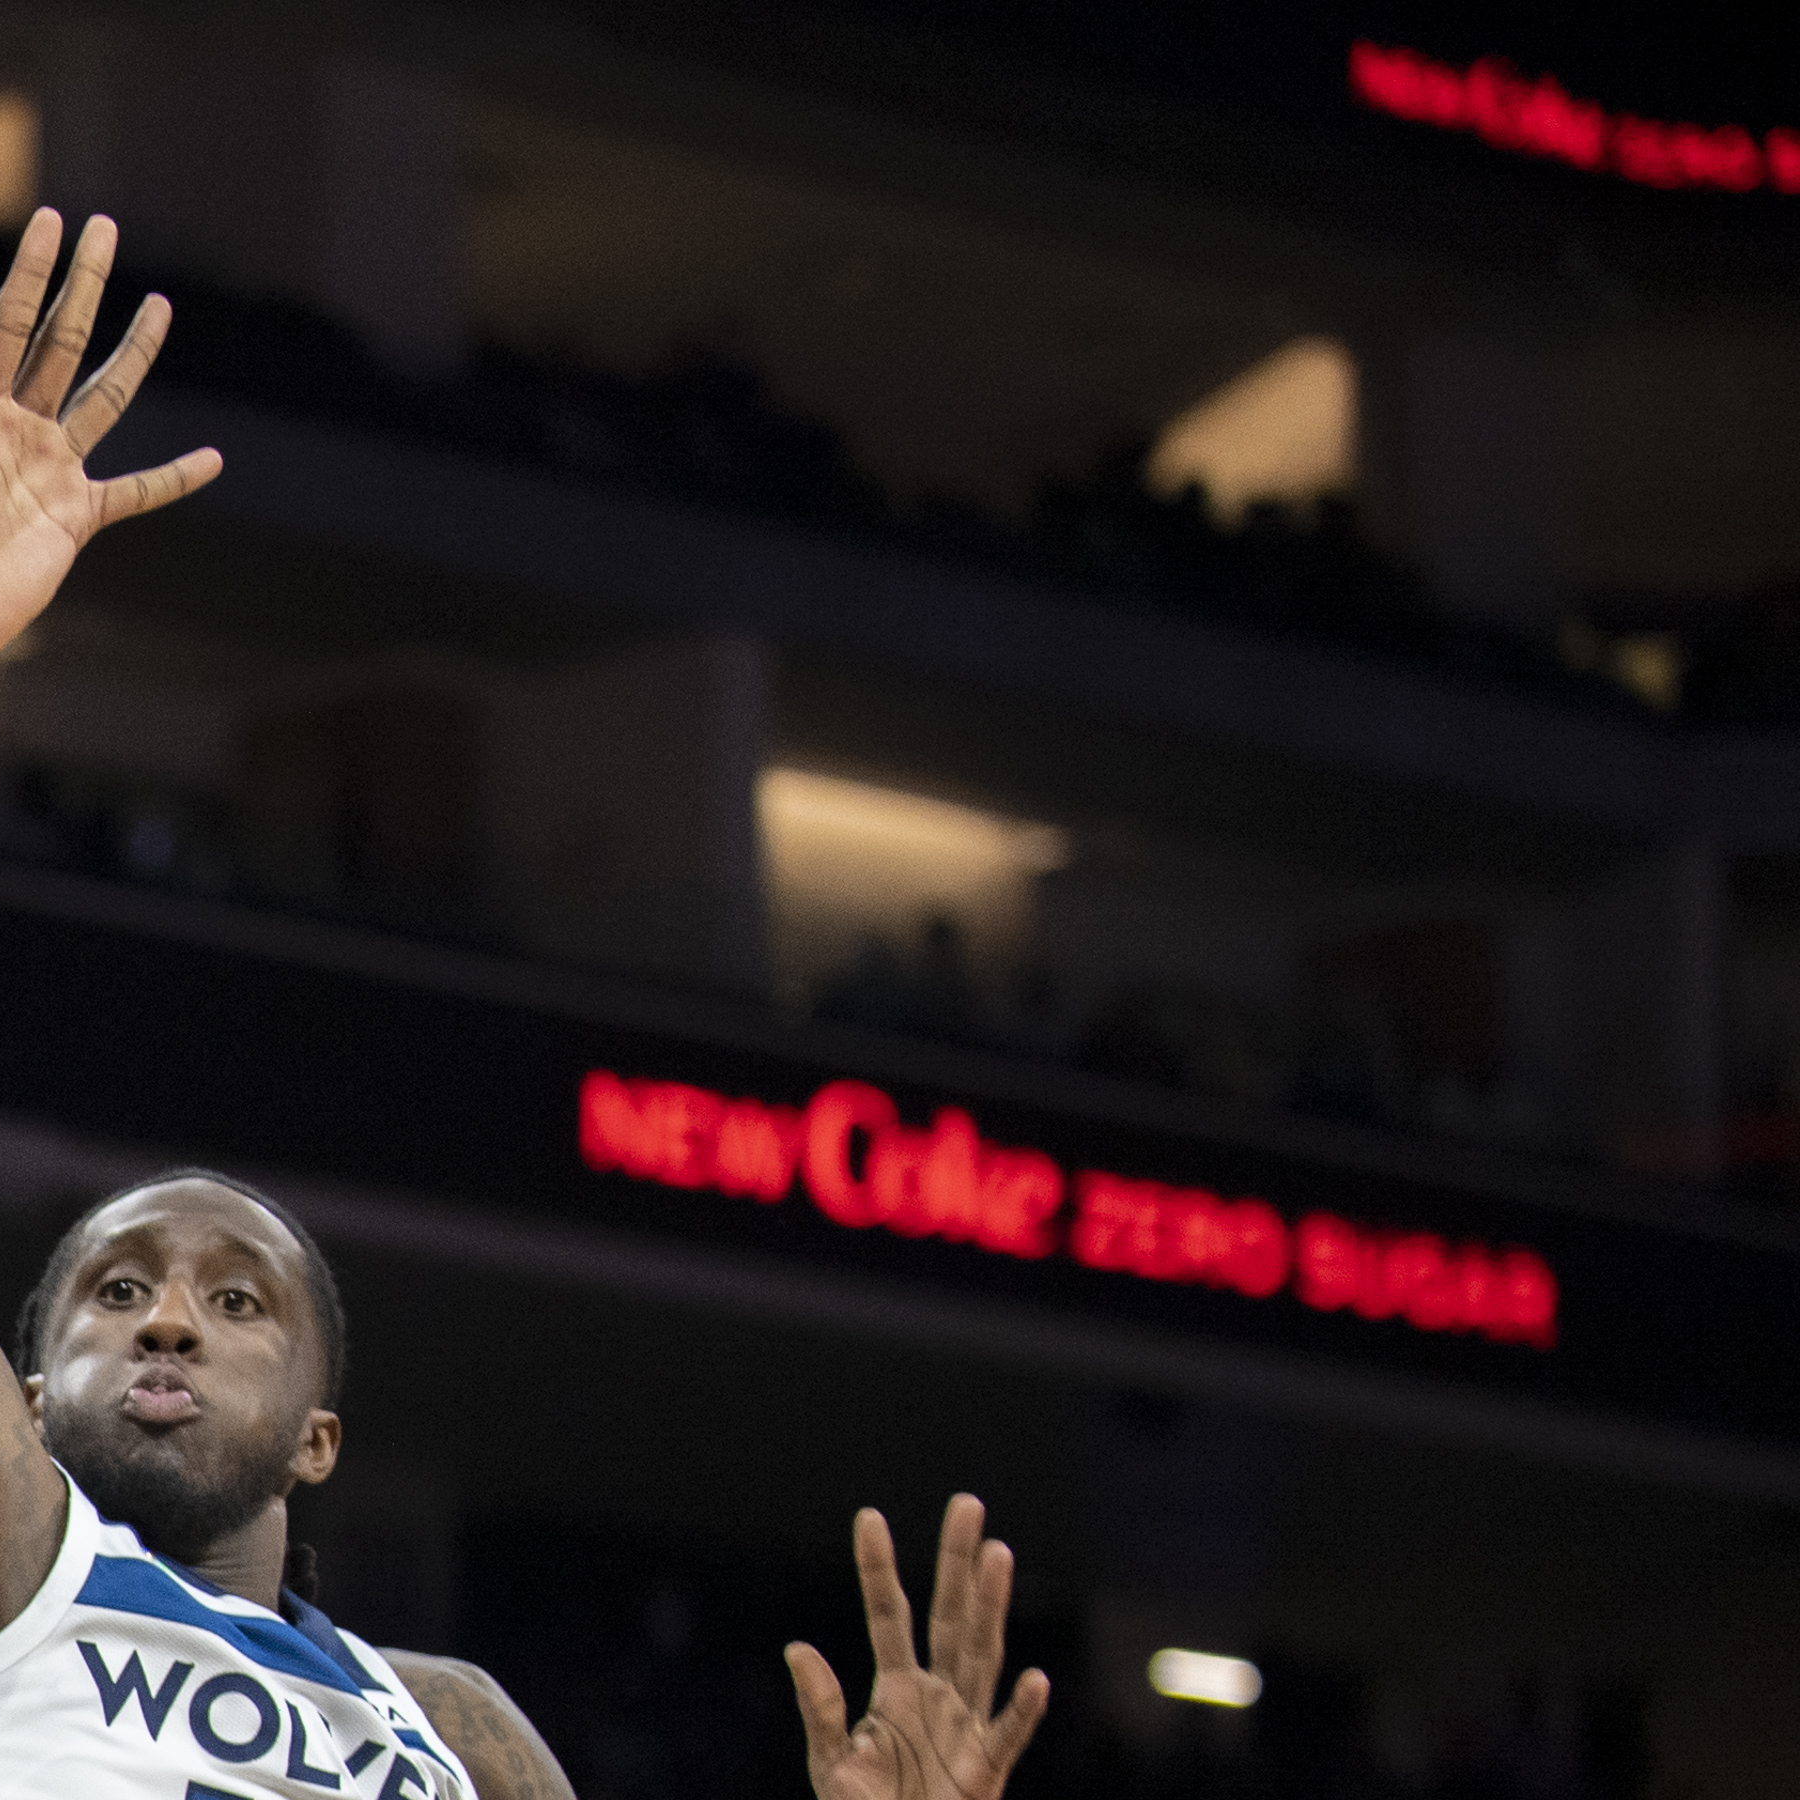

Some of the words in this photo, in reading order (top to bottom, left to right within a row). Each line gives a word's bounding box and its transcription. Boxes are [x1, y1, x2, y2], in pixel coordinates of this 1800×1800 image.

[578, 1068, 802, 1205] NEW
[800, 1079, 1065, 1260] Coke
[1070, 1168, 1292, 1299] ZERO
[1294, 1209, 1560, 1350] SUGAR
